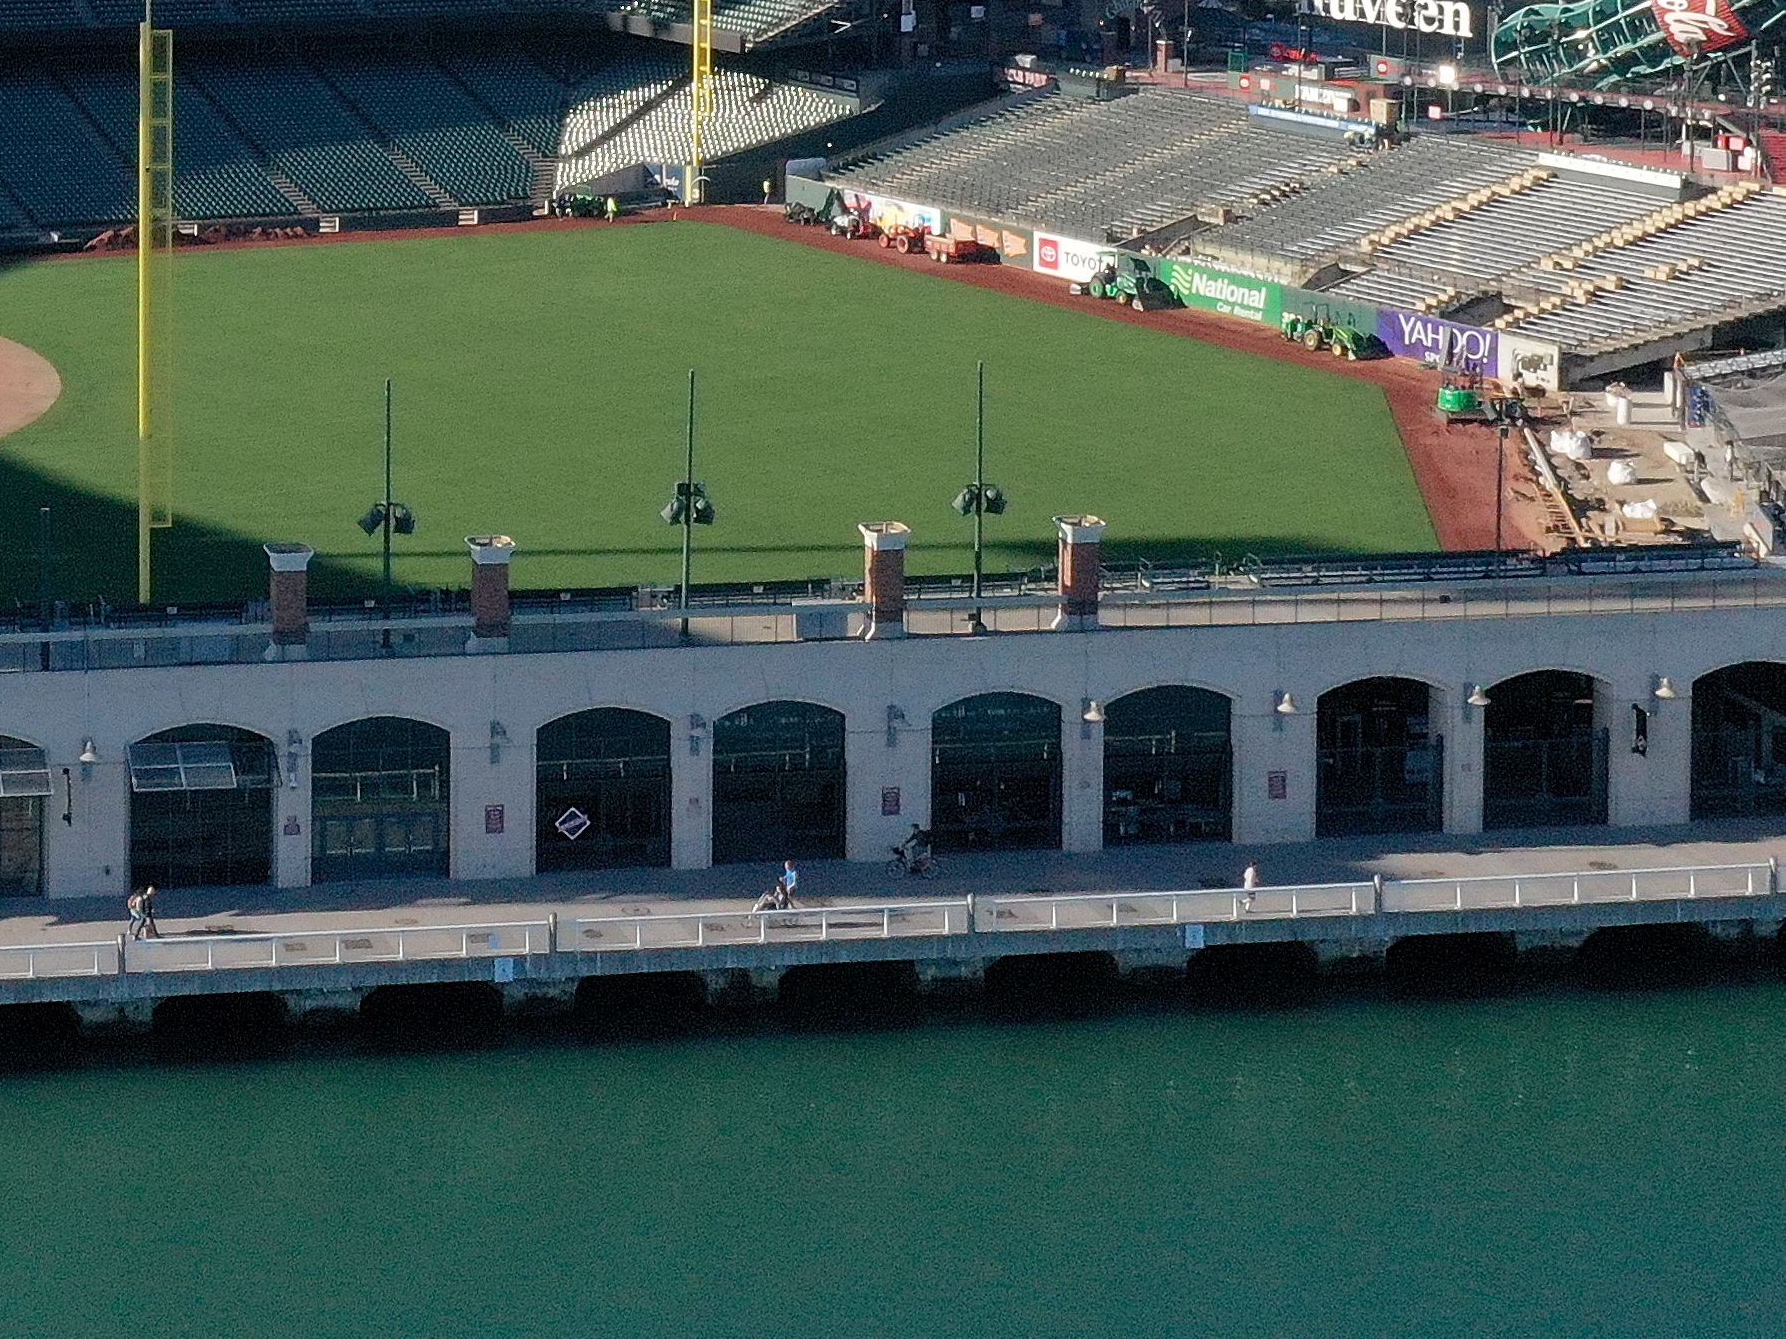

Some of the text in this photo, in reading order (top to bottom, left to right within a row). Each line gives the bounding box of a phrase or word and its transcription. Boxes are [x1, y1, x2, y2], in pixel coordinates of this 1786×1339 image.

[1063, 251, 1100, 271] TOYO
[1190, 271, 1267, 309] National
[1216, 301, 1263, 321] Car Rental
